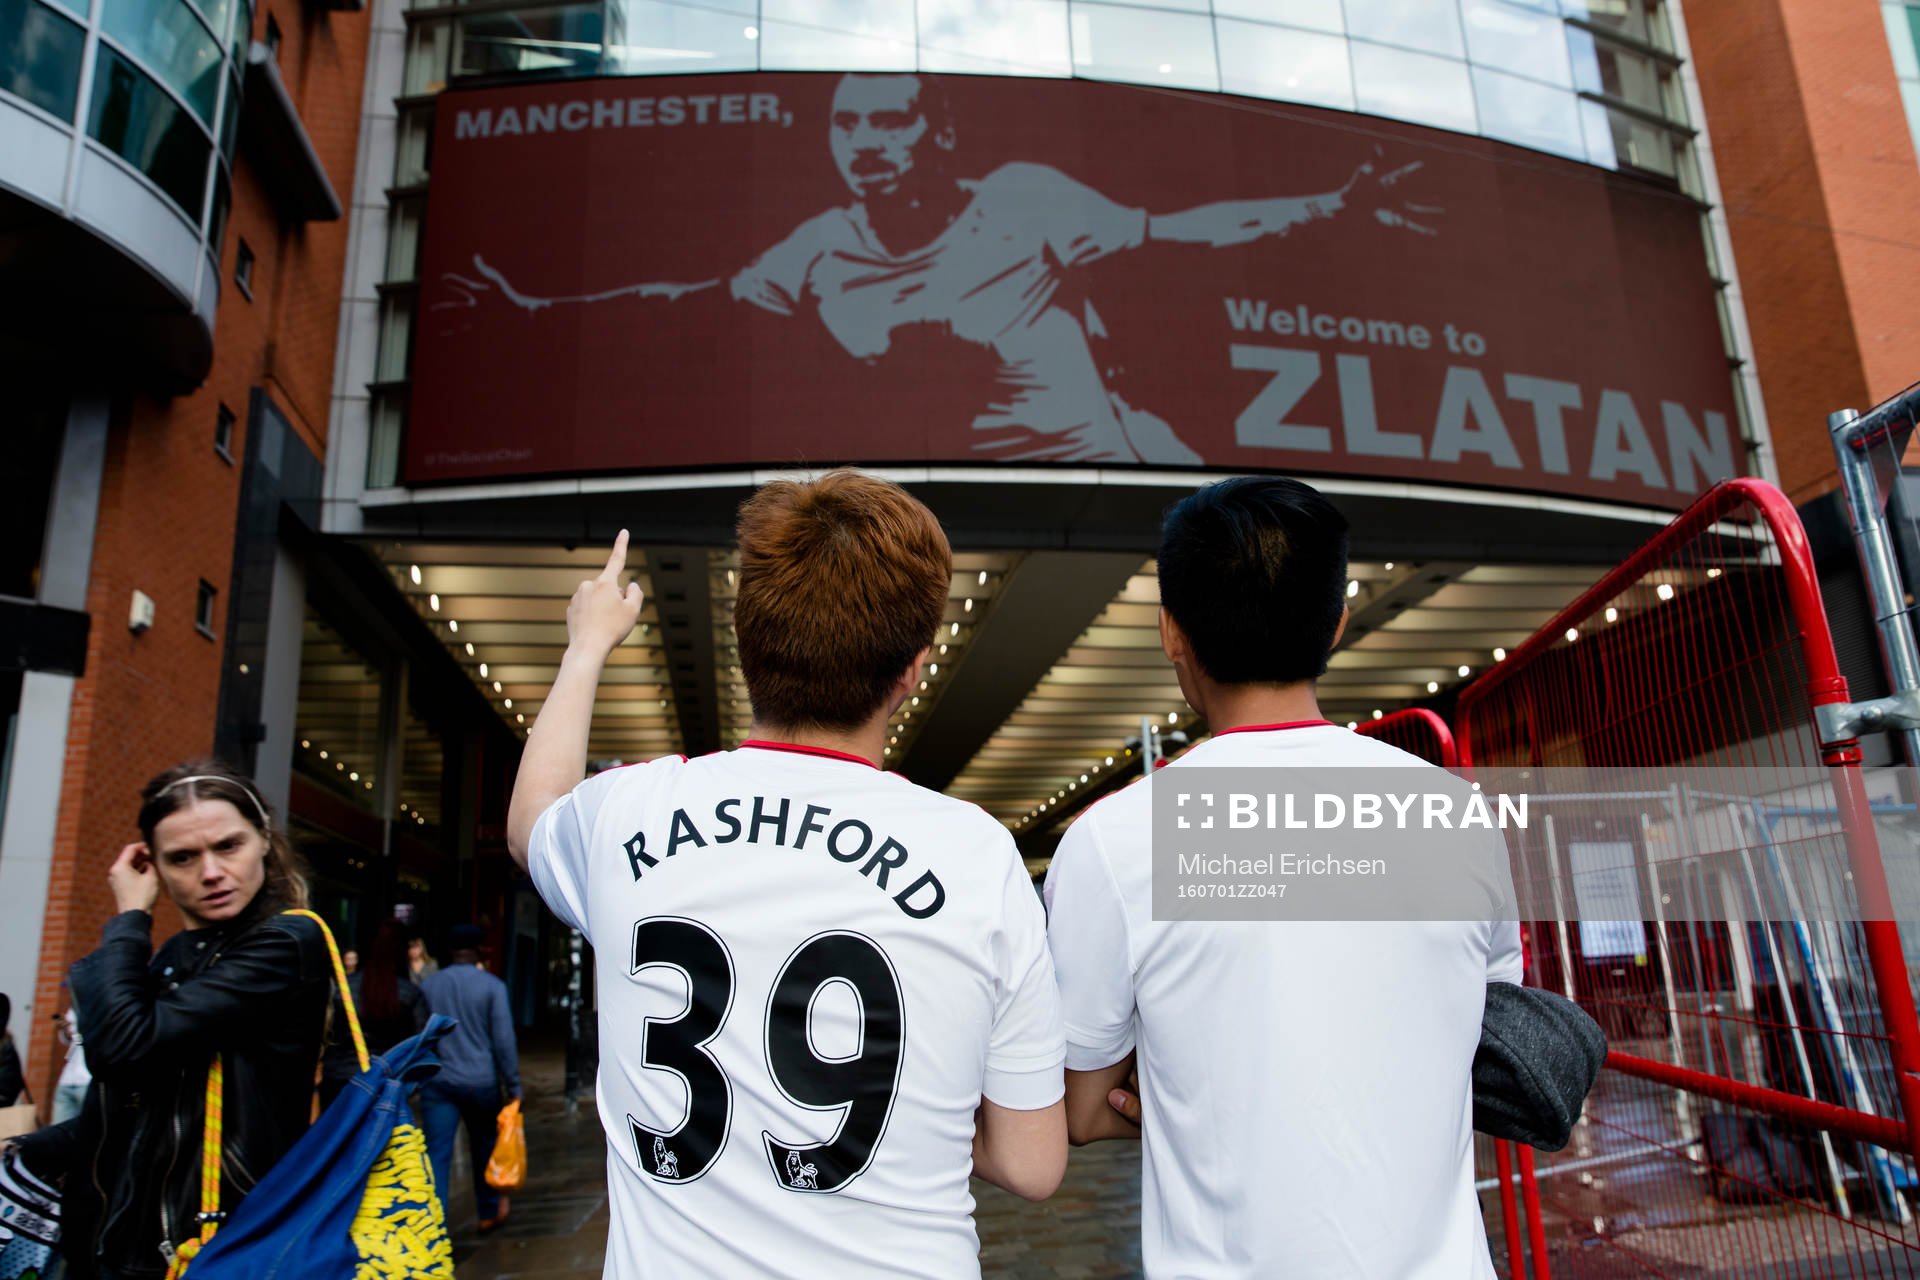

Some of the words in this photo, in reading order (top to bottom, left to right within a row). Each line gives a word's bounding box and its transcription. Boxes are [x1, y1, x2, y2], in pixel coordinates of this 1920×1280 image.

[456, 93, 794, 140] MANCHESTER,
[1225, 298, 1431, 350] Welcome
[1443, 323, 1487, 356] to
[1229, 343, 1736, 494] ZLATAN
[622, 796, 946, 919] RASHFORD
[627, 915, 906, 1193] 39
